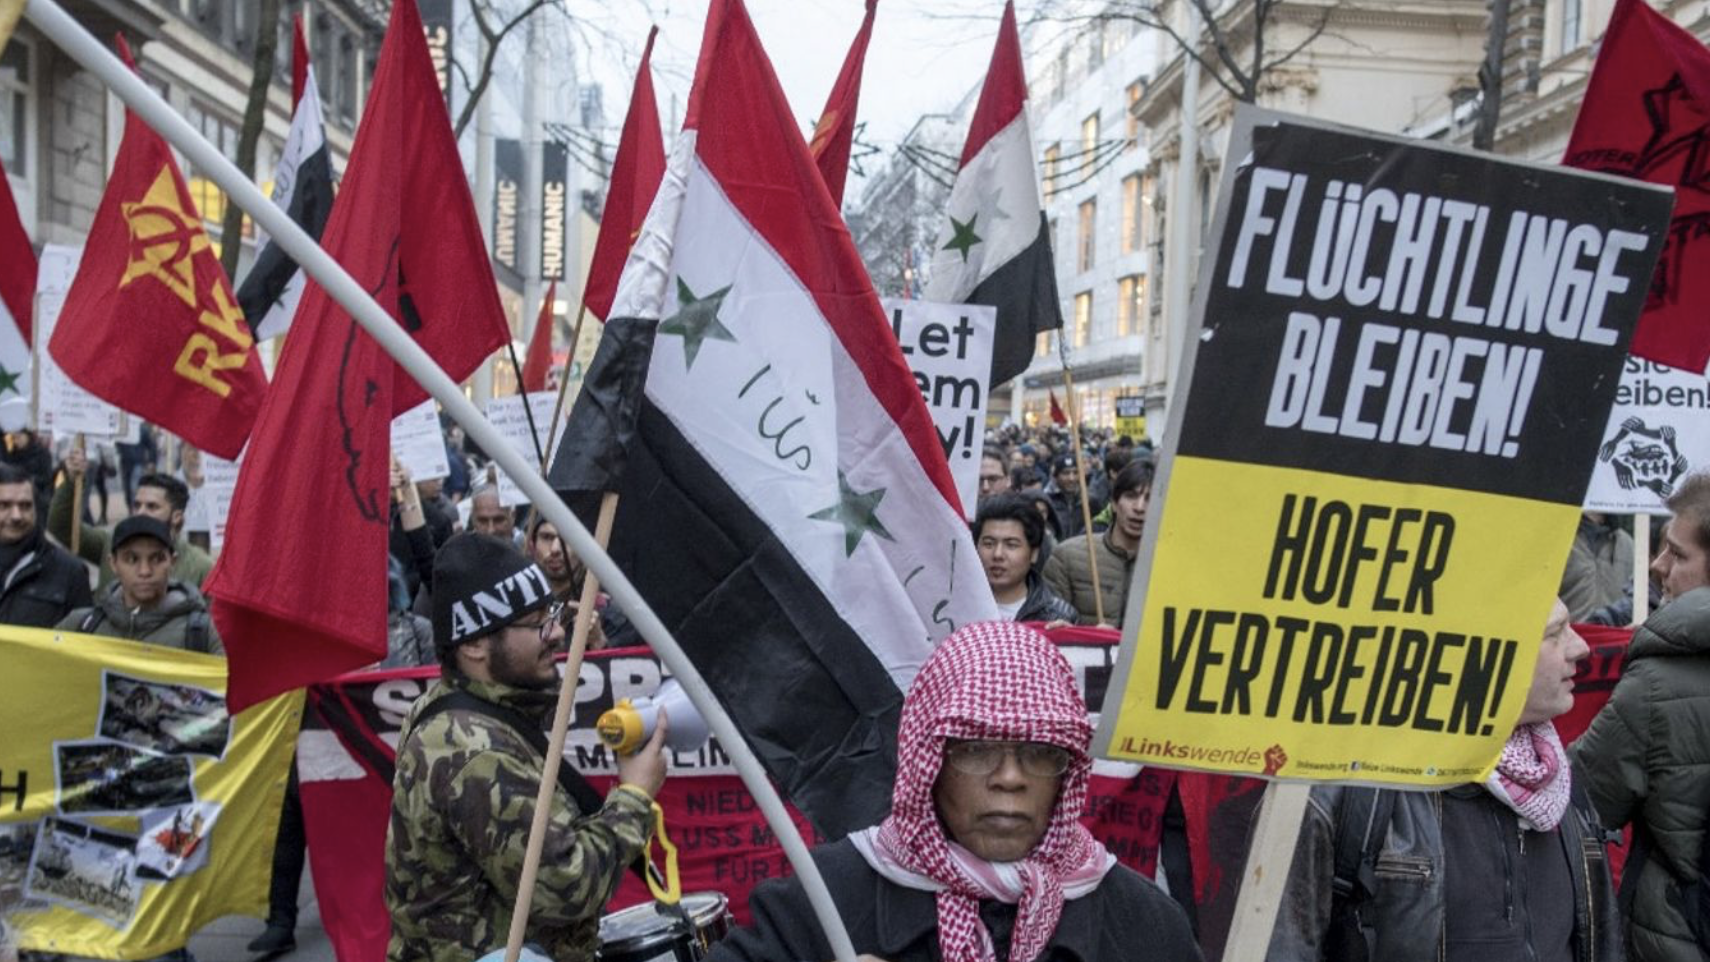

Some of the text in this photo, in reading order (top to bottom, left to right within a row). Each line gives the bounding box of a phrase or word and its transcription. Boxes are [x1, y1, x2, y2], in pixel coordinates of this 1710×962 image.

[543, 182, 564, 278] HUMANIC
[1226, 167, 1649, 346] FLÜCHTLINGE
[893, 309, 974, 360] Let
[912, 371, 980, 410] em
[1264, 313, 1543, 459] BLEIBEN!
[1614, 379, 1710, 410] eiben!
[934, 416, 975, 460] y!
[1262, 493, 1456, 615] HOFER
[451, 563, 552, 640] ANTI
[1154, 607, 1519, 737] VERTREIBEN!
[1126, 738, 1261, 767] Linkswende
[687, 790, 757, 816] NIED
